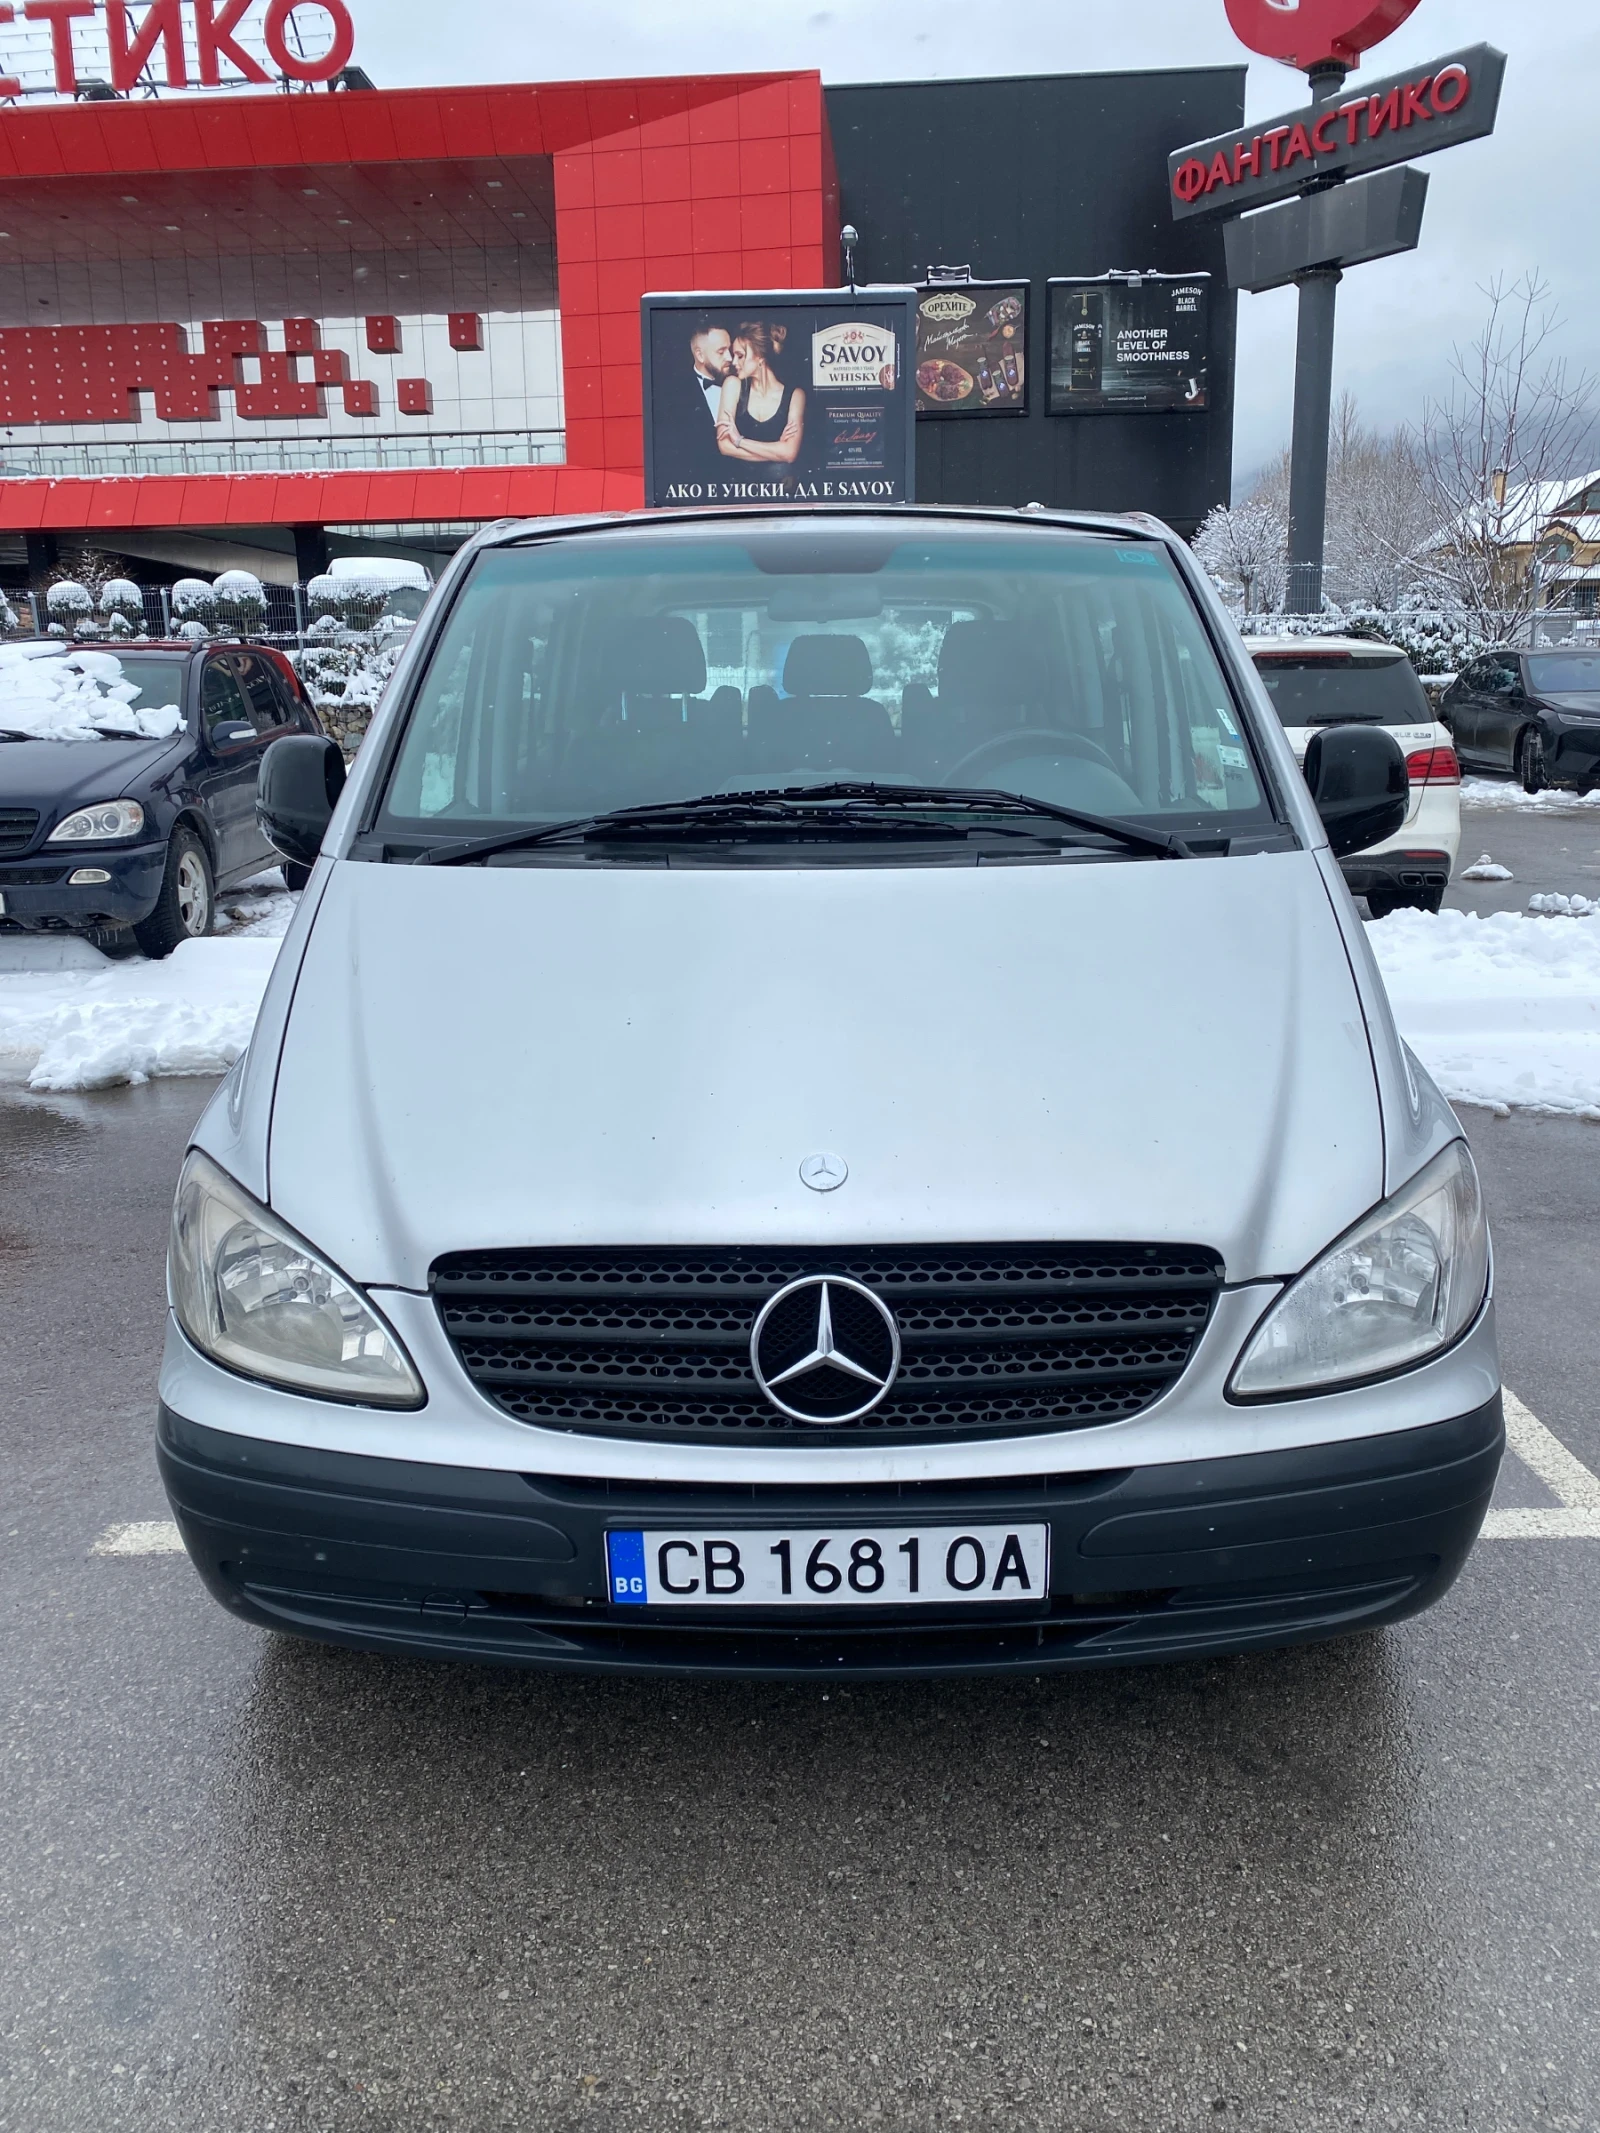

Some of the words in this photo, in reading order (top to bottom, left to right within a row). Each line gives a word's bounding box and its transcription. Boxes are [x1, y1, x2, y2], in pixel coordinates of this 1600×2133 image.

[1172, 63, 1471, 202] ФАНТАСТИКО
[1171, 287, 1203, 297] JAMESON
[1177, 297, 1195, 305] BLACK
[927, 301, 968, 313] ОРЕХИТЕ
[1175, 304, 1198, 312] BARREL
[1116, 328, 1168, 340] ANOTHER
[1116, 341, 1150, 351] LEVEL
[1151, 340, 1167, 350] OF
[820, 343, 888, 368] SAVOY
[1116, 350, 1190, 361] SMOOTHNESS
[829, 372, 879, 382] WHISKY
[665, 484, 702, 498] АКО
[707, 484, 718, 498] Е
[721, 482, 790, 498] УИСКИ,
[794, 482, 818, 499] ДА
[823, 482, 834, 496] Е
[838, 481, 895, 496] SAVOY
[615, 1577, 643, 1594] BG
